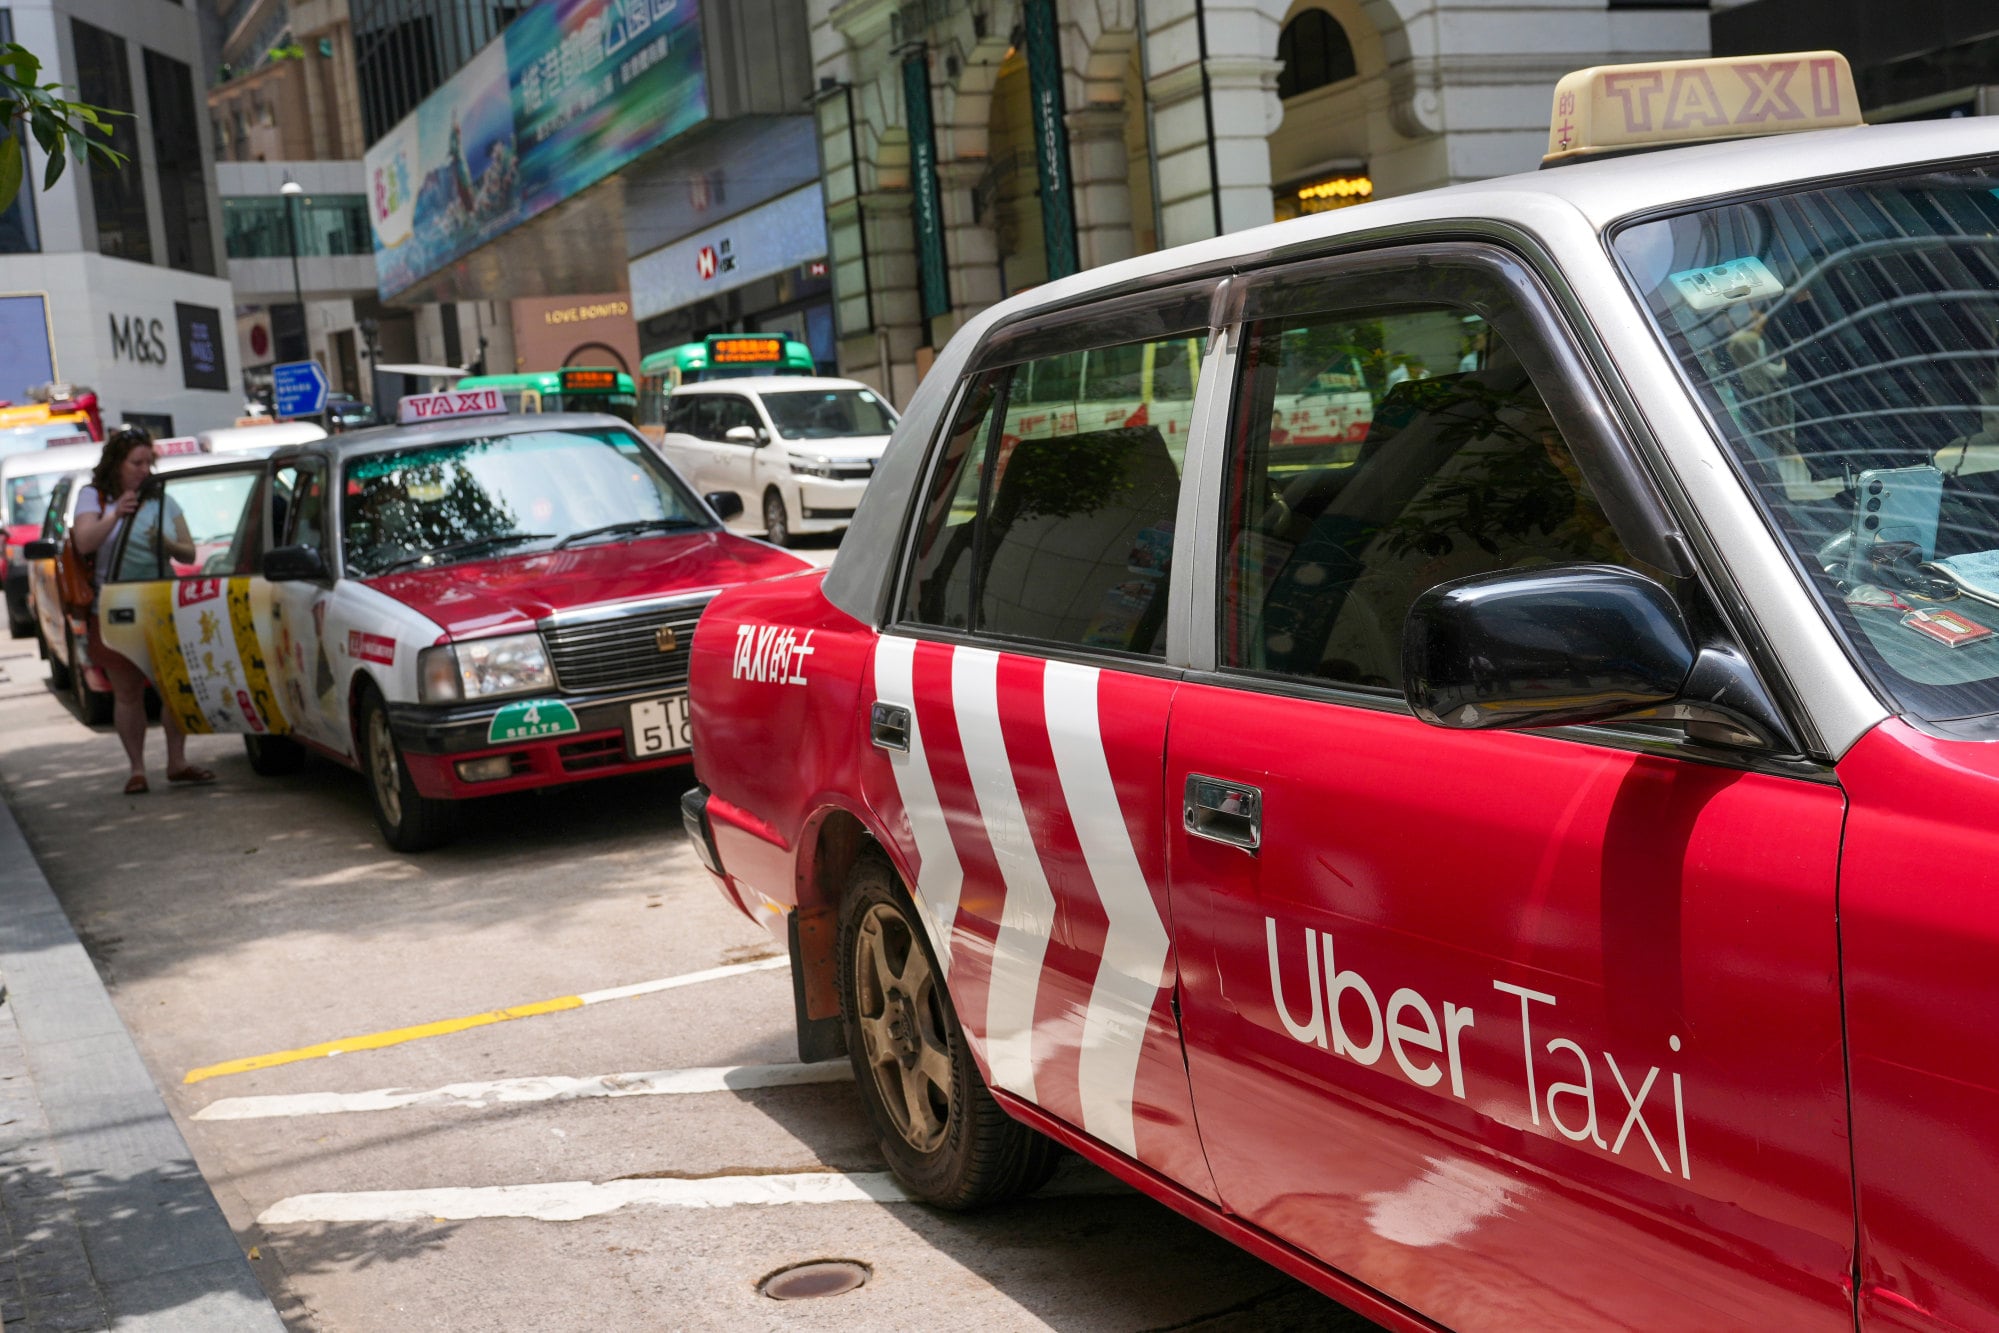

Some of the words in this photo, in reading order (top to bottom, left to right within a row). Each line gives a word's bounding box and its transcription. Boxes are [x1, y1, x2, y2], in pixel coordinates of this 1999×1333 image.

[1558, 90, 1575, 144] 的士
[1604, 58, 1840, 133] TAXI
[917, 144, 933, 233] LACOSTE
[109, 311, 167, 366] M&S
[408, 390, 497, 417] TAXI
[506, 721, 560, 739] SEATS
[523, 706, 541, 724] 4
[1265, 917, 1474, 1099] Uber
[1493, 980, 1691, 1180] Taxi
